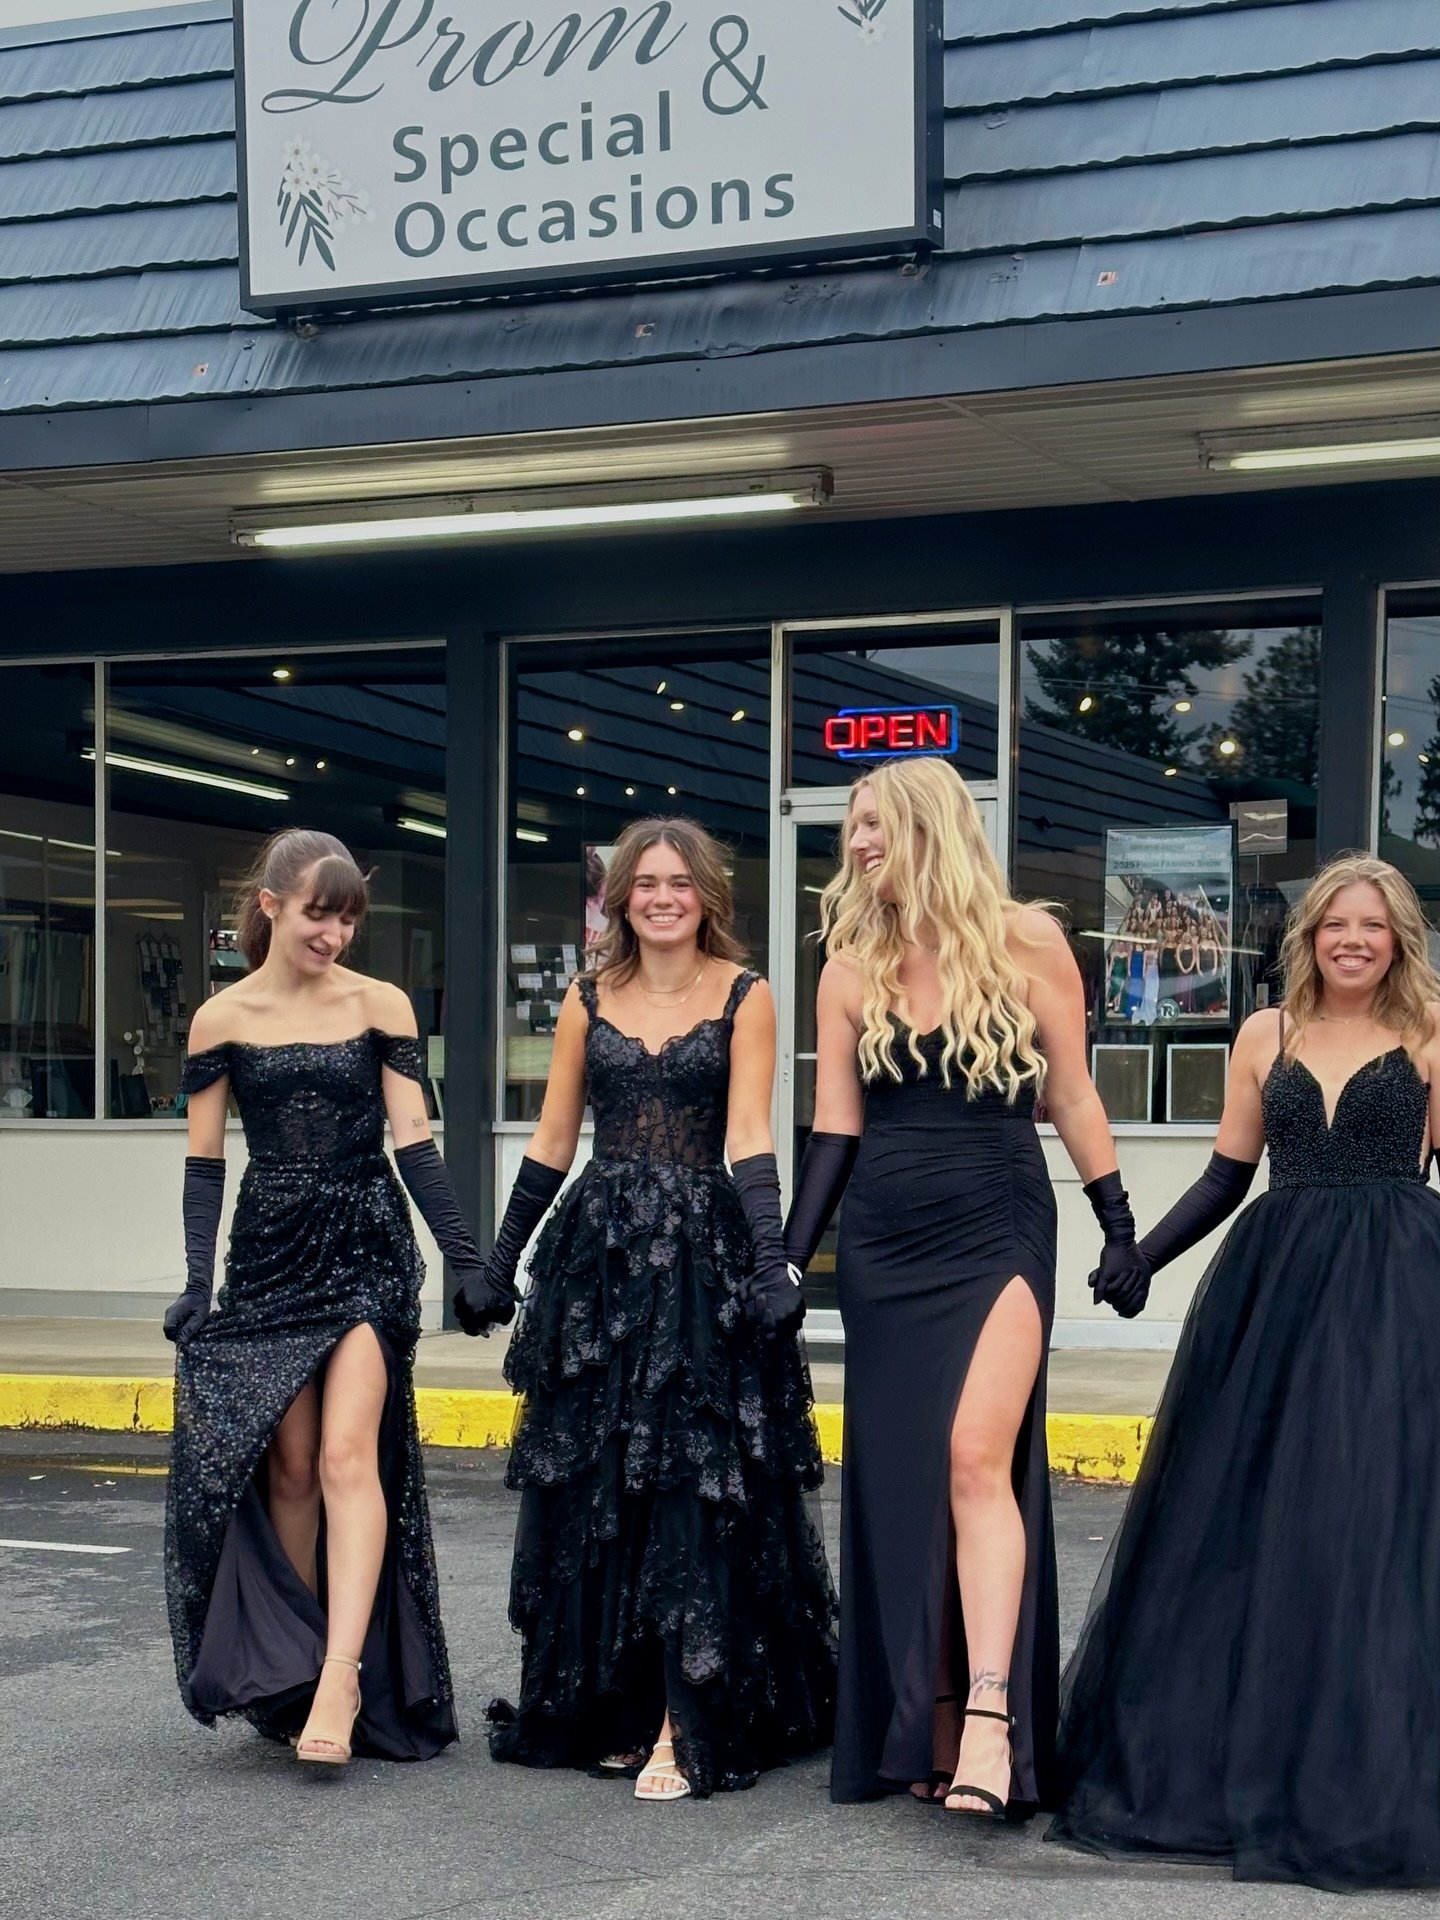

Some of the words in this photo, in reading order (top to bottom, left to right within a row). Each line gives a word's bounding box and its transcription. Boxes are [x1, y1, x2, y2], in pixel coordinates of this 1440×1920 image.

[260, 0, 688, 113] Prom
[701, 14, 770, 116] &
[392, 91, 672, 194] Special
[395, 172, 796, 258] Occasions
[824, 712, 948, 751] OPEN
